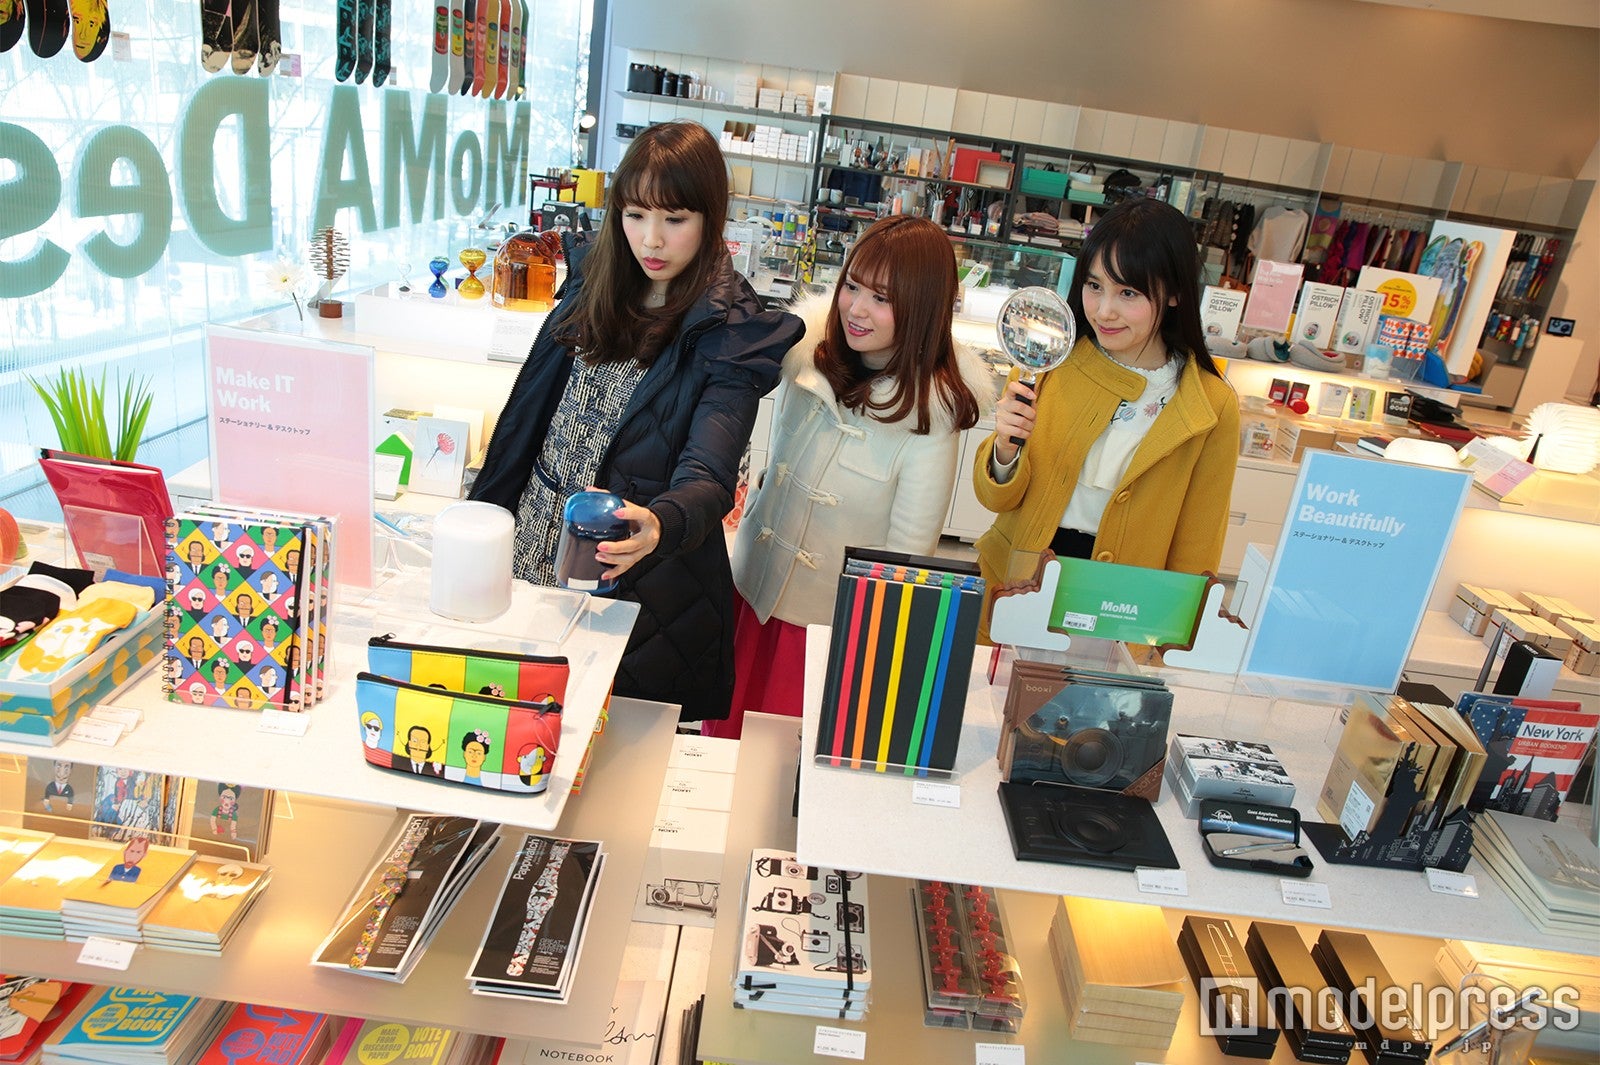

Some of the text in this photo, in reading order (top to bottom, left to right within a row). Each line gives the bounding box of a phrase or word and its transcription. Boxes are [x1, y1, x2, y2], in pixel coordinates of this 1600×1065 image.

[1210, 298, 1239, 308] OSTRICH
[1311, 294, 1339, 303] OSTRICH
[1363, 295, 1375, 325] OSTRICH
[216, 365, 295, 394] Make IT
[216, 388, 272, 414] Work
[1306, 482, 1361, 507] Work
[1297, 504, 1406, 537] Beautifully
[1292, 530, 1341, 543] ステーショナリー
[1347, 538, 1386, 549] デスクトップ
[1100, 600, 1139, 616] MoMA
[1025, 684, 1052, 693] booxi
[1522, 724, 1585, 741] New York
[1517, 739, 1567, 750] URBAN BOOKEND
[512, 837, 541, 881] Pappwatch
[127, 1006, 180, 1019] NOTE
[116, 1018, 169, 1032] BOOK
[380, 1028, 400, 1036] MADE
[268, 1031, 303, 1049] NOTE
[376, 1036, 397, 1044] FROM
[410, 1026, 443, 1042] NOTE
[256, 1046, 292, 1065] PAD
[362, 1043, 402, 1052] DISCARDED
[367, 1051, 390, 1059] PAPER
[403, 1041, 438, 1059] BOOK
[539, 1048, 615, 1063] NOTEBOOK
